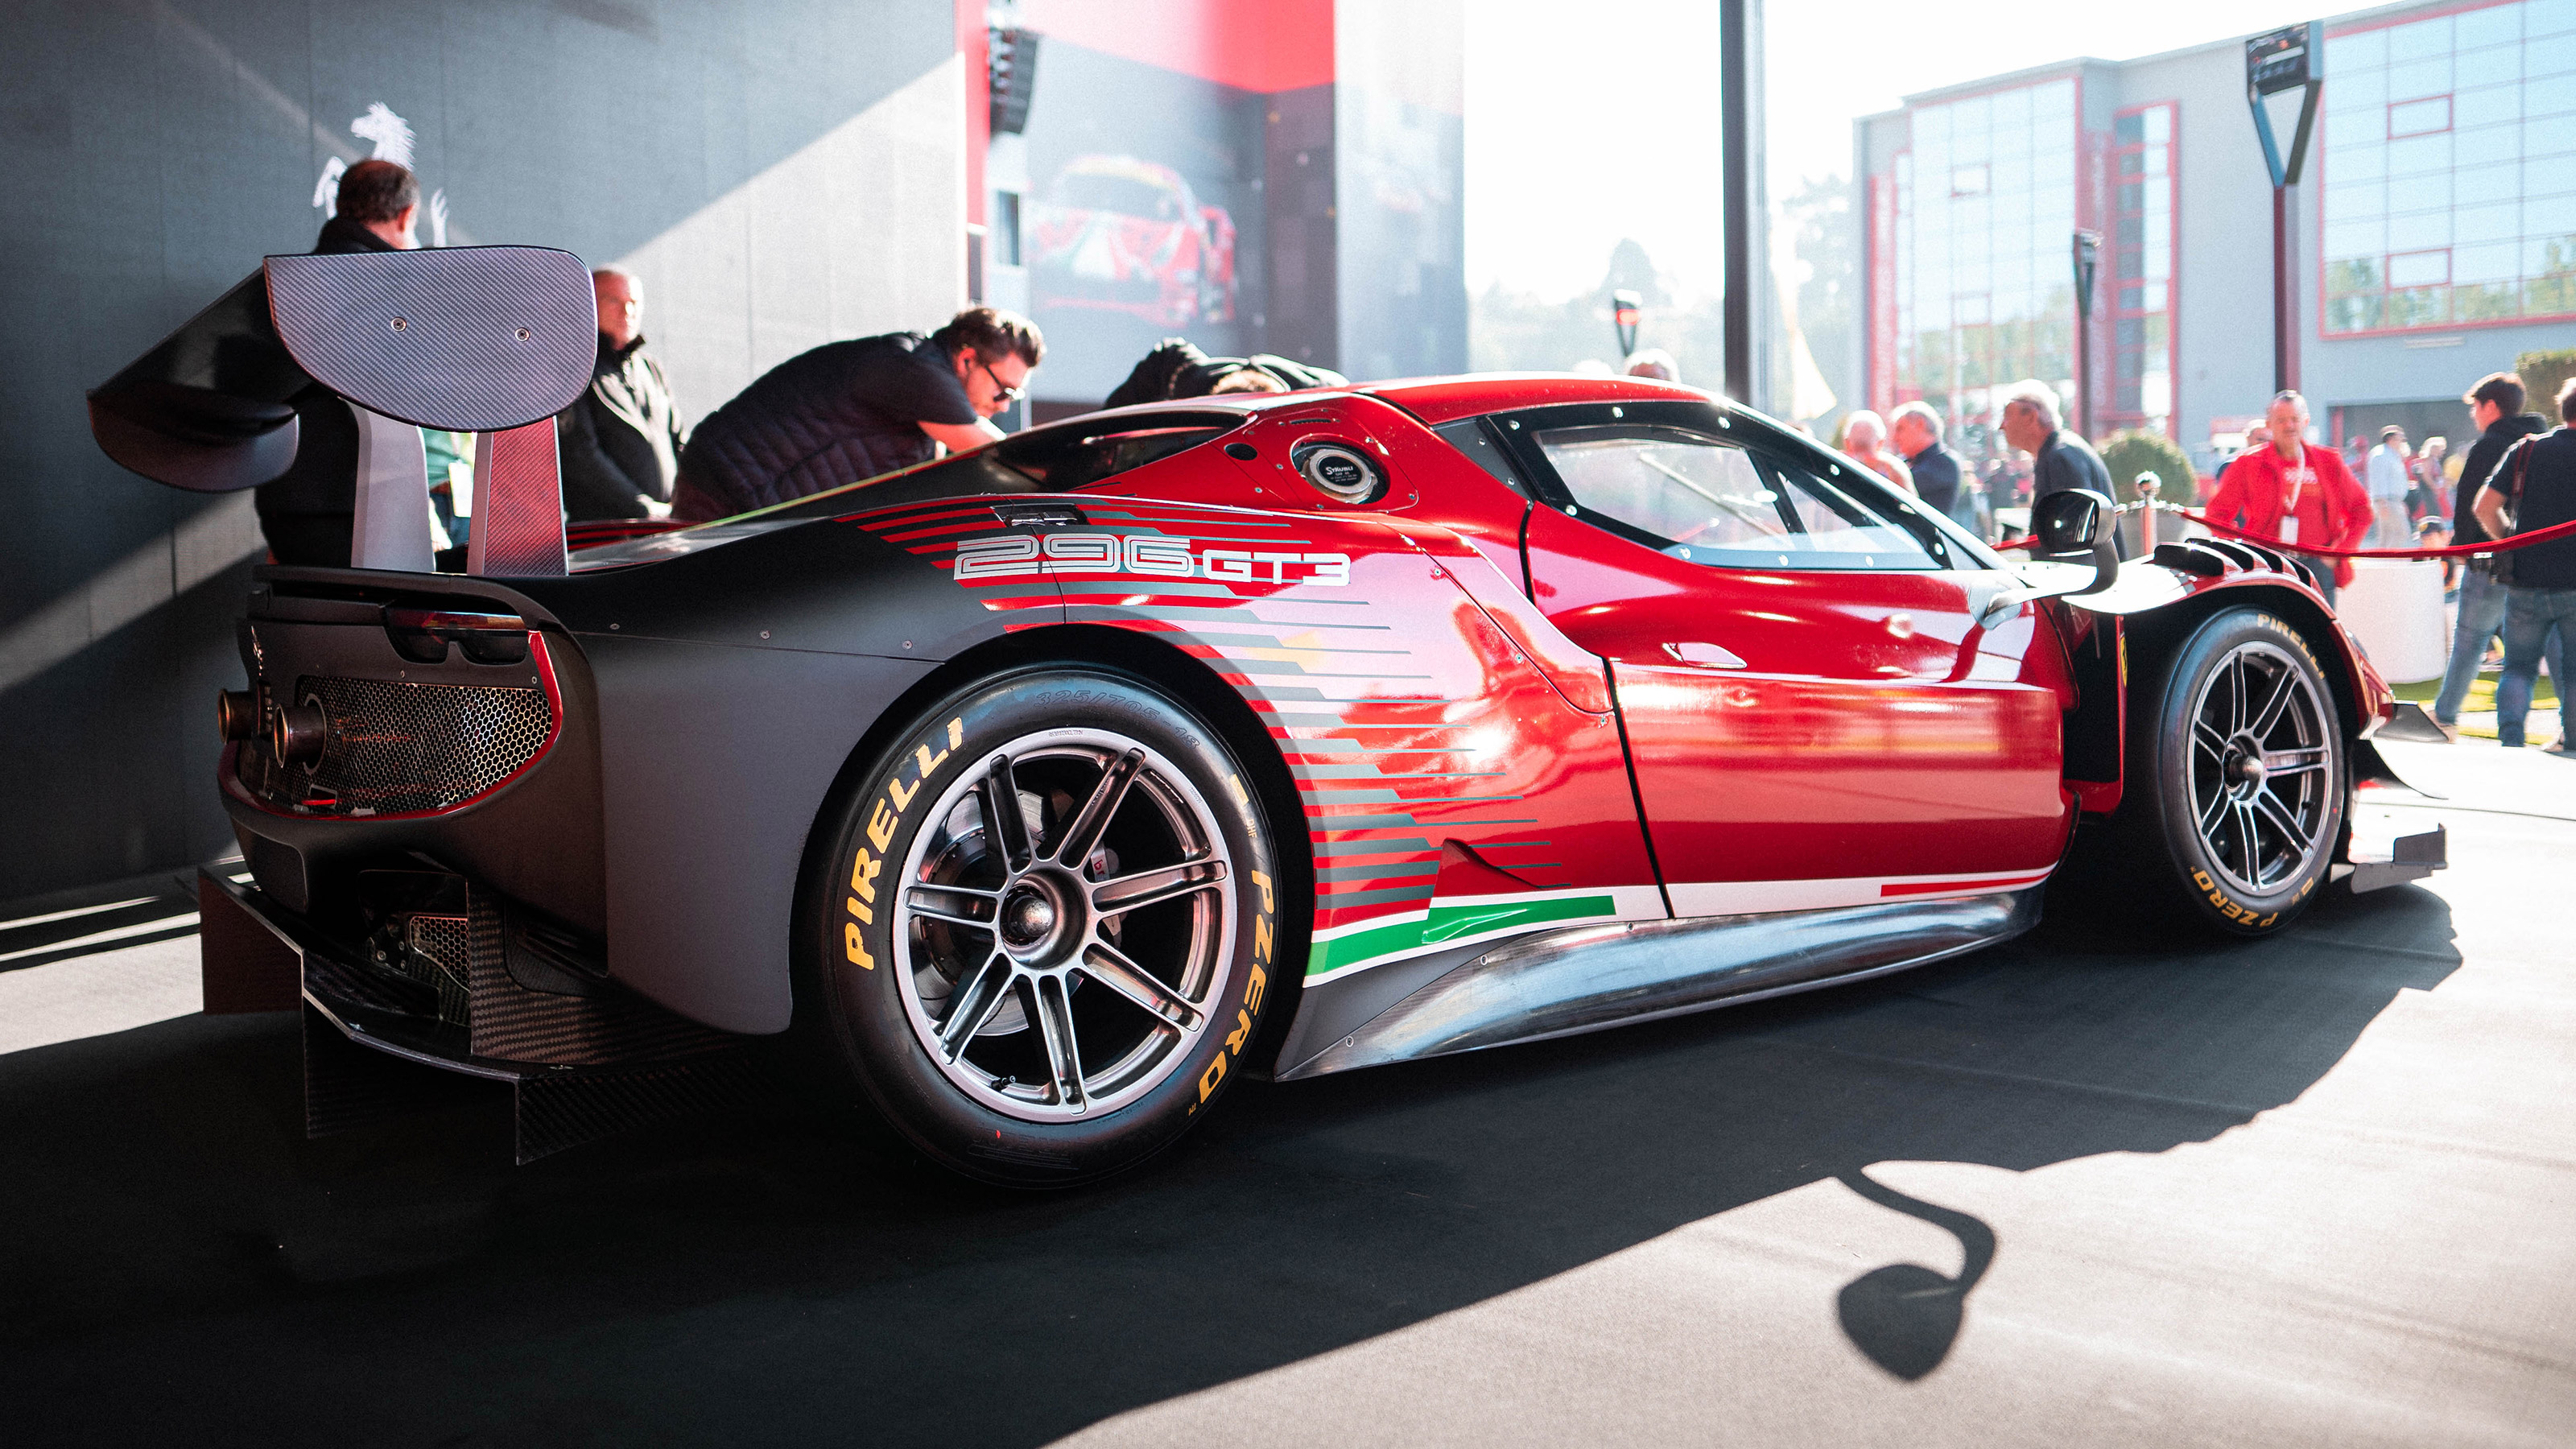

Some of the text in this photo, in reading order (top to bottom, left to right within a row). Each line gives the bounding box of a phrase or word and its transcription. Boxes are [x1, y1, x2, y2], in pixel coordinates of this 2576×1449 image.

[953, 533, 1352, 587] 296 GT3
[2257, 613, 2325, 679] PIRELLI
[844, 716, 964, 970] PIRELLI
[1245, 818, 1257, 838] DHF
